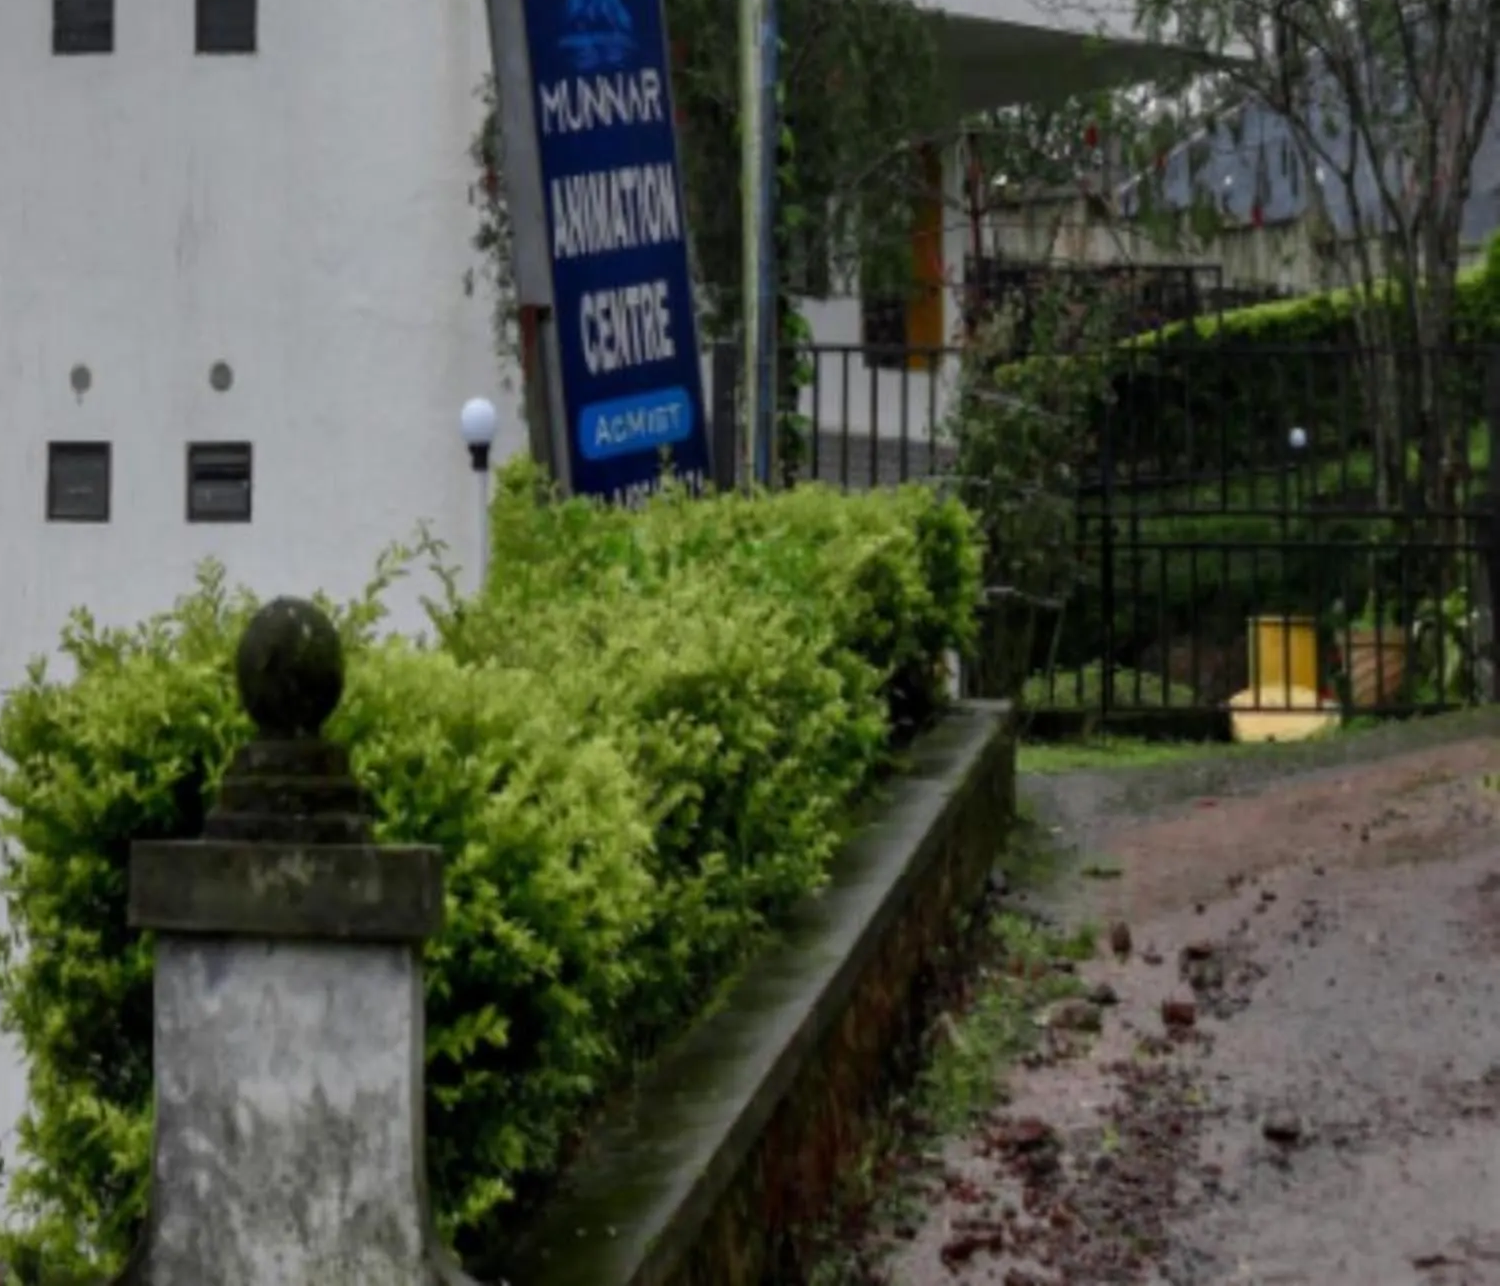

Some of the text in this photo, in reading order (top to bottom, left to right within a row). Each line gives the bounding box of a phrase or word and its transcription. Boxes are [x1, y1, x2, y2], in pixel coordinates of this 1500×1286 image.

[539, 68, 663, 135] MUNNAR
[551, 163, 679, 260] ANIMATION
[580, 280, 675, 375] CENTRE
